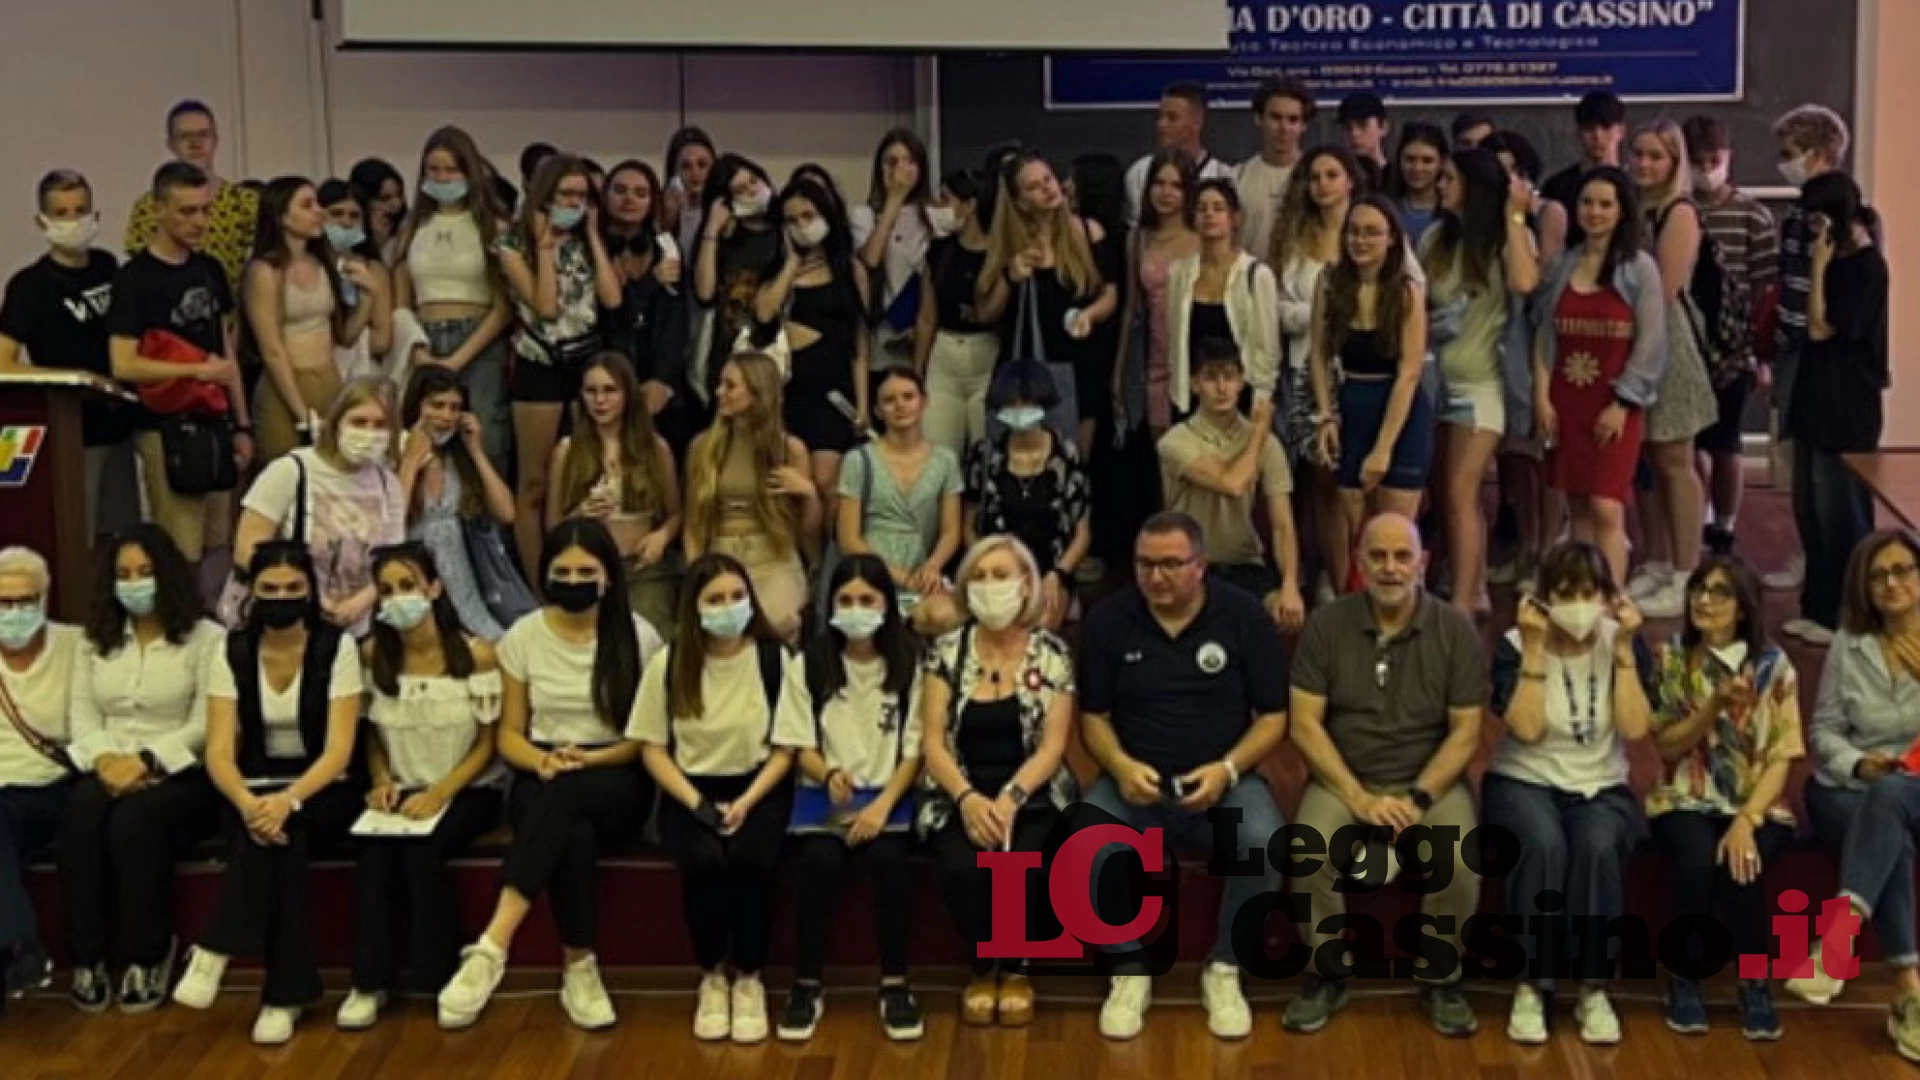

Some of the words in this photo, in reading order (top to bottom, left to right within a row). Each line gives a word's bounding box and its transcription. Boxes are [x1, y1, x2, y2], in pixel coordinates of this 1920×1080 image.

[1267, 3, 1373, 32] D'ORO
[1402, 0, 1496, 31] CITTÀ
[1507, 1, 1541, 29] DI
